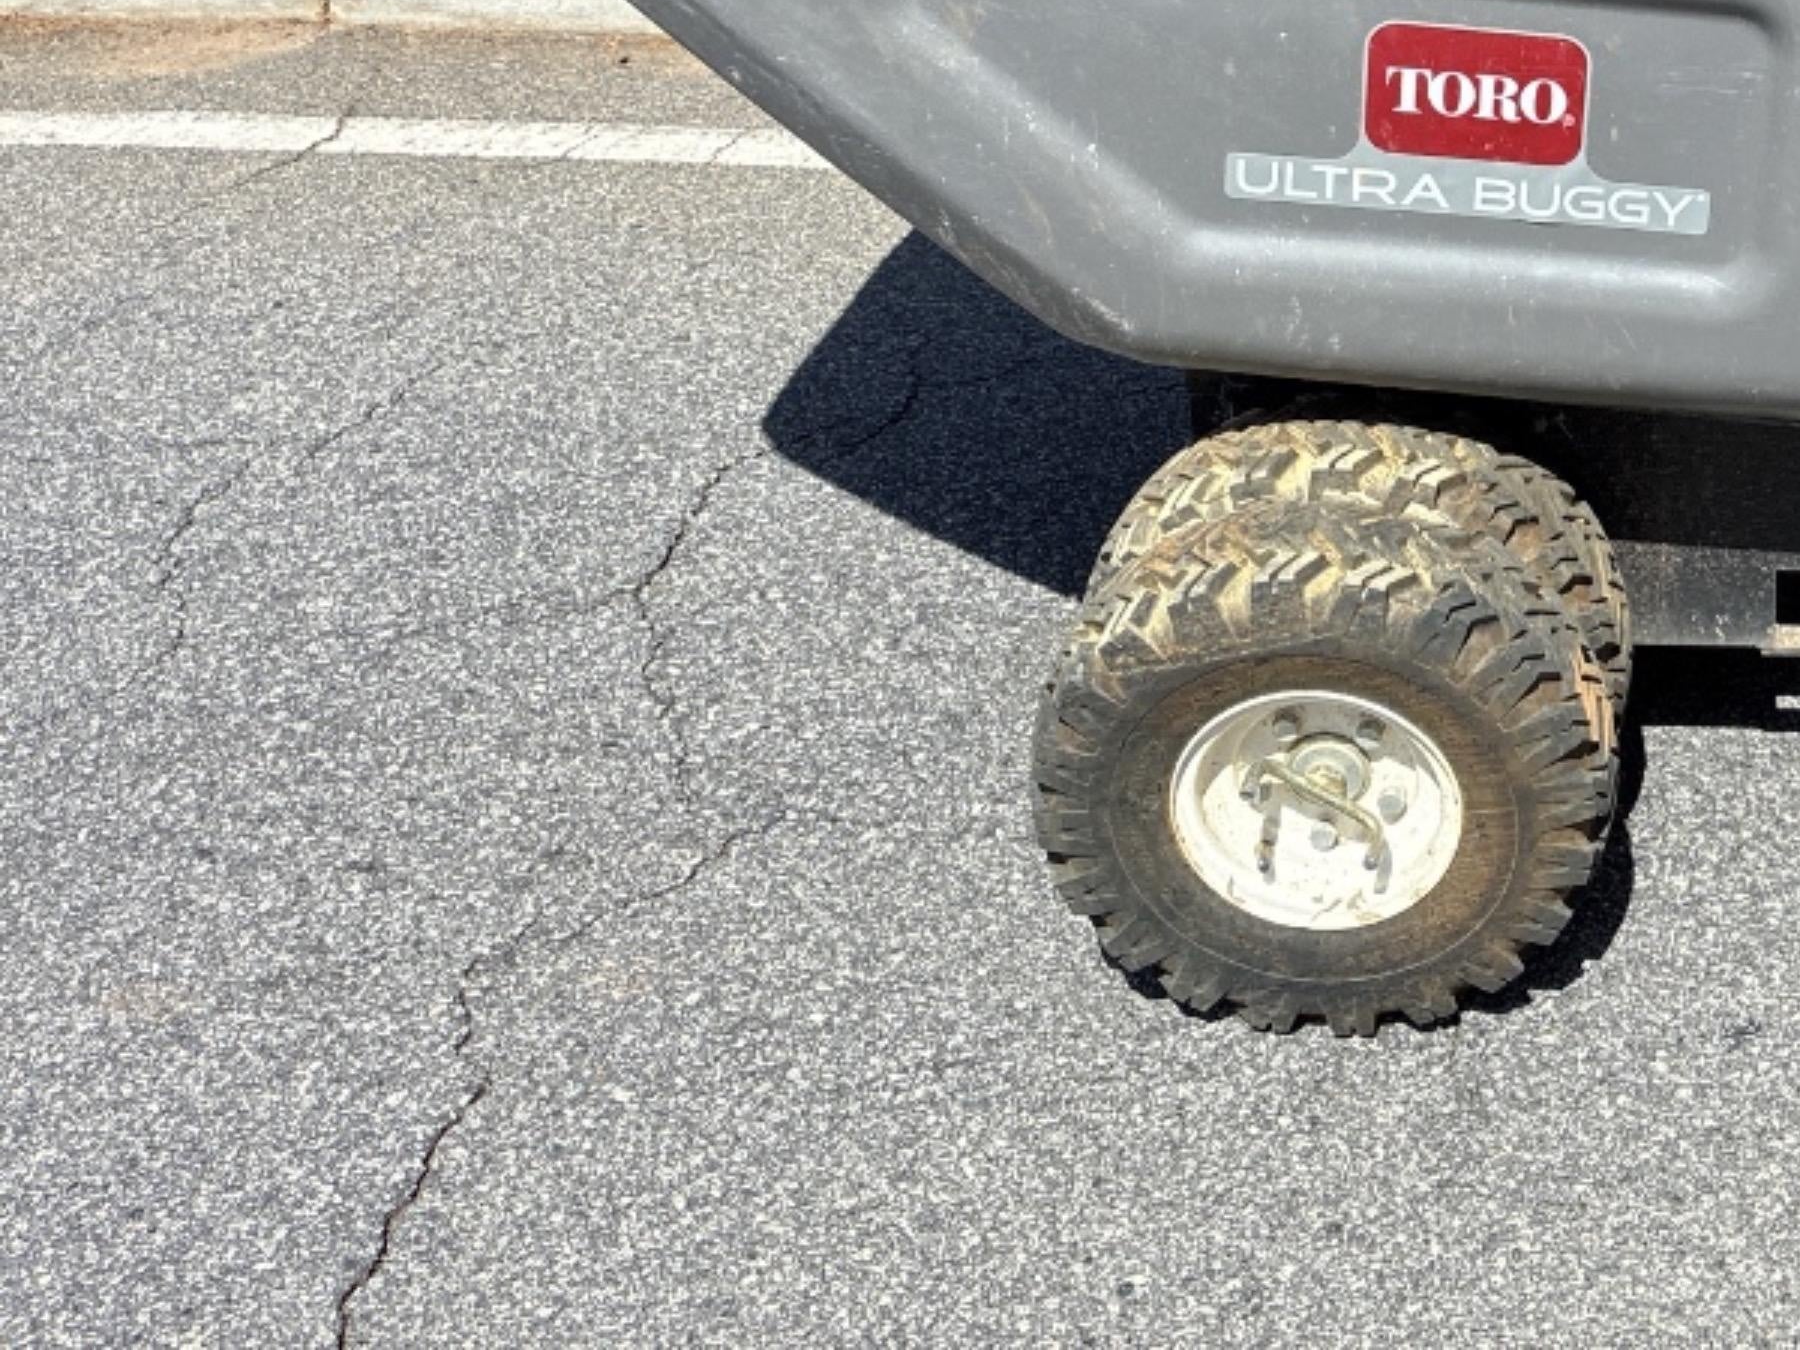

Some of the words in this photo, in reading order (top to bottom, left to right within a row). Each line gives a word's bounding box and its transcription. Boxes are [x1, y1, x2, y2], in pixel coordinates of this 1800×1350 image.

[1385, 64, 1568, 125] TORO
[1236, 158, 1449, 208] ULTRA
[1474, 174, 1691, 228] BUGGY
